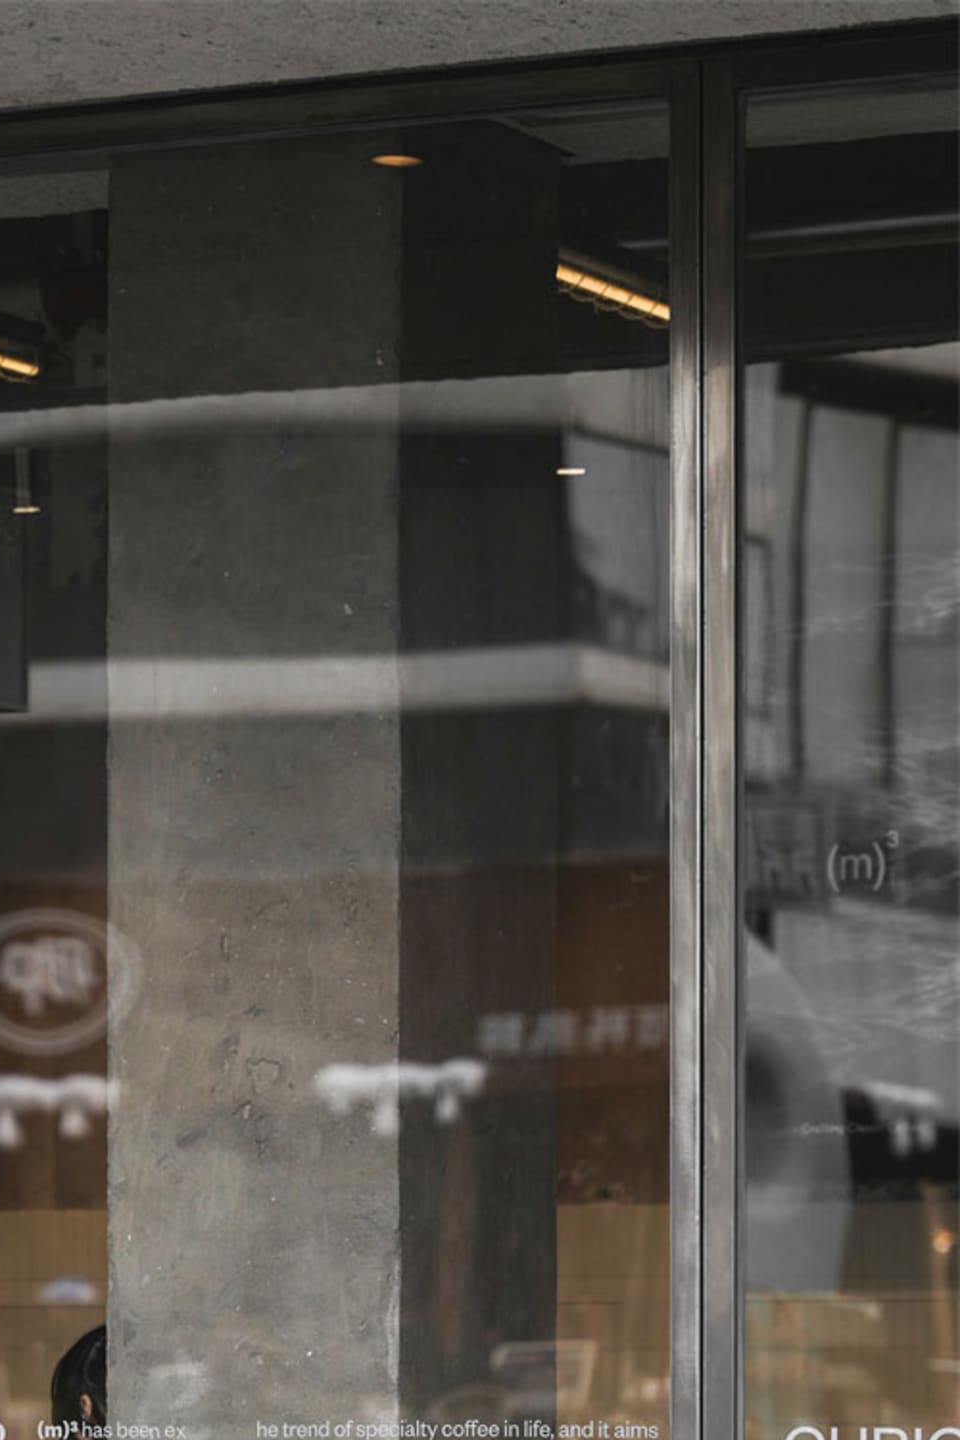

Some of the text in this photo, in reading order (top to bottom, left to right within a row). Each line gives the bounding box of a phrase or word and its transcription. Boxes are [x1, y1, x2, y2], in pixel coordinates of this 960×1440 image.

[81, 1421, 113, 1439] has
[116, 1421, 161, 1440] been
[282, 1421, 330, 1439] trend
[334, 1421, 353, 1439] of
[441, 1421, 501, 1439] coffee
[504, 1421, 520, 1439] in
[523, 1421, 555, 1440] life,
[558, 1422, 594, 1440] and
[597, 1422, 611, 1440] it
[613, 1422, 659, 1440] aims
